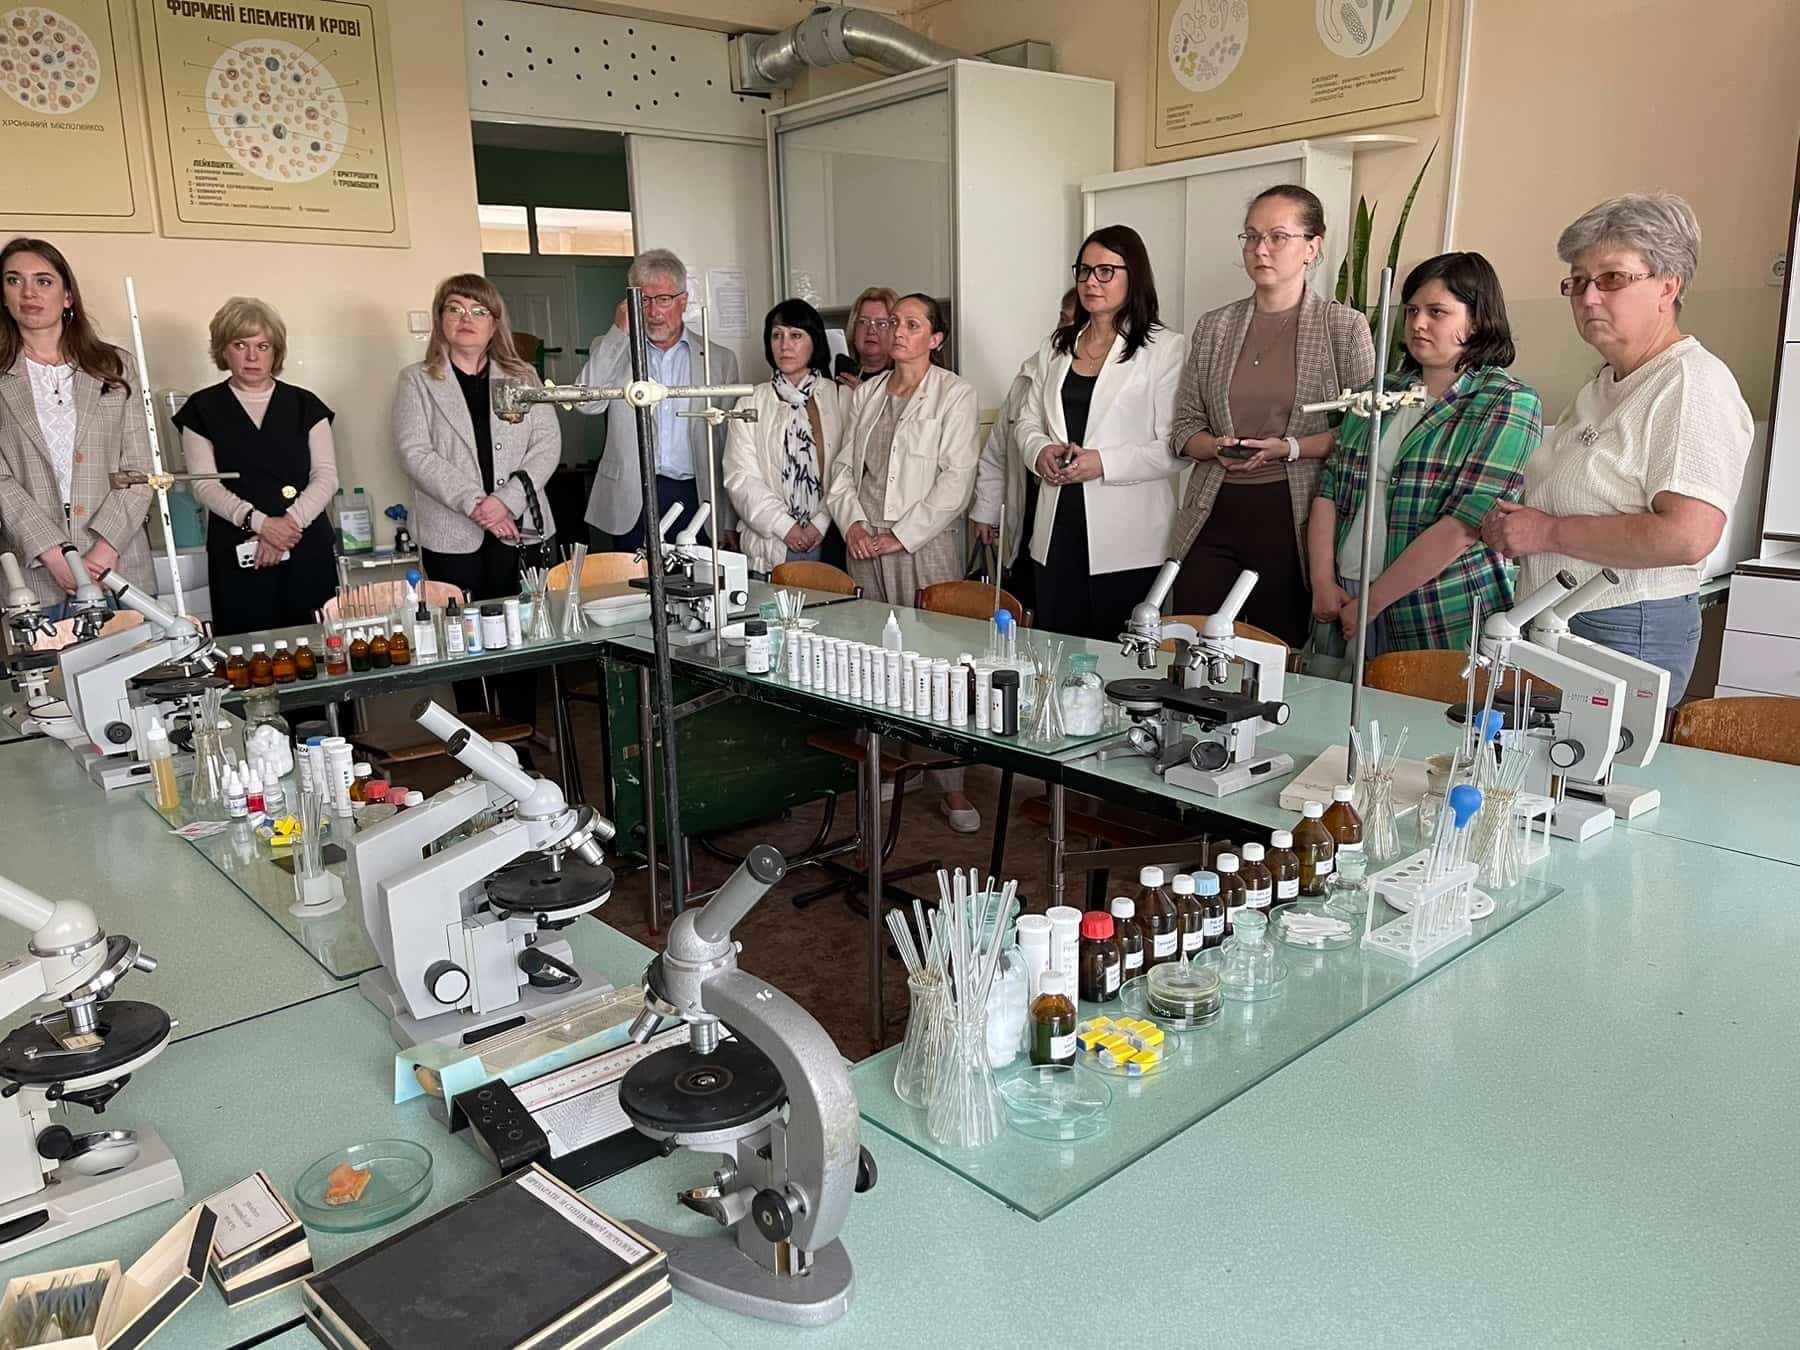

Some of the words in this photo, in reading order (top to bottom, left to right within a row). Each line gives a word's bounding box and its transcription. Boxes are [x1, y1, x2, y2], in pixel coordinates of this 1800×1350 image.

[167, 0, 235, 22] ФОРМЕНІ
[239, 7, 315, 31] ЕЛЕМЕНТИ
[320, 16, 361, 37] КРОВІ
